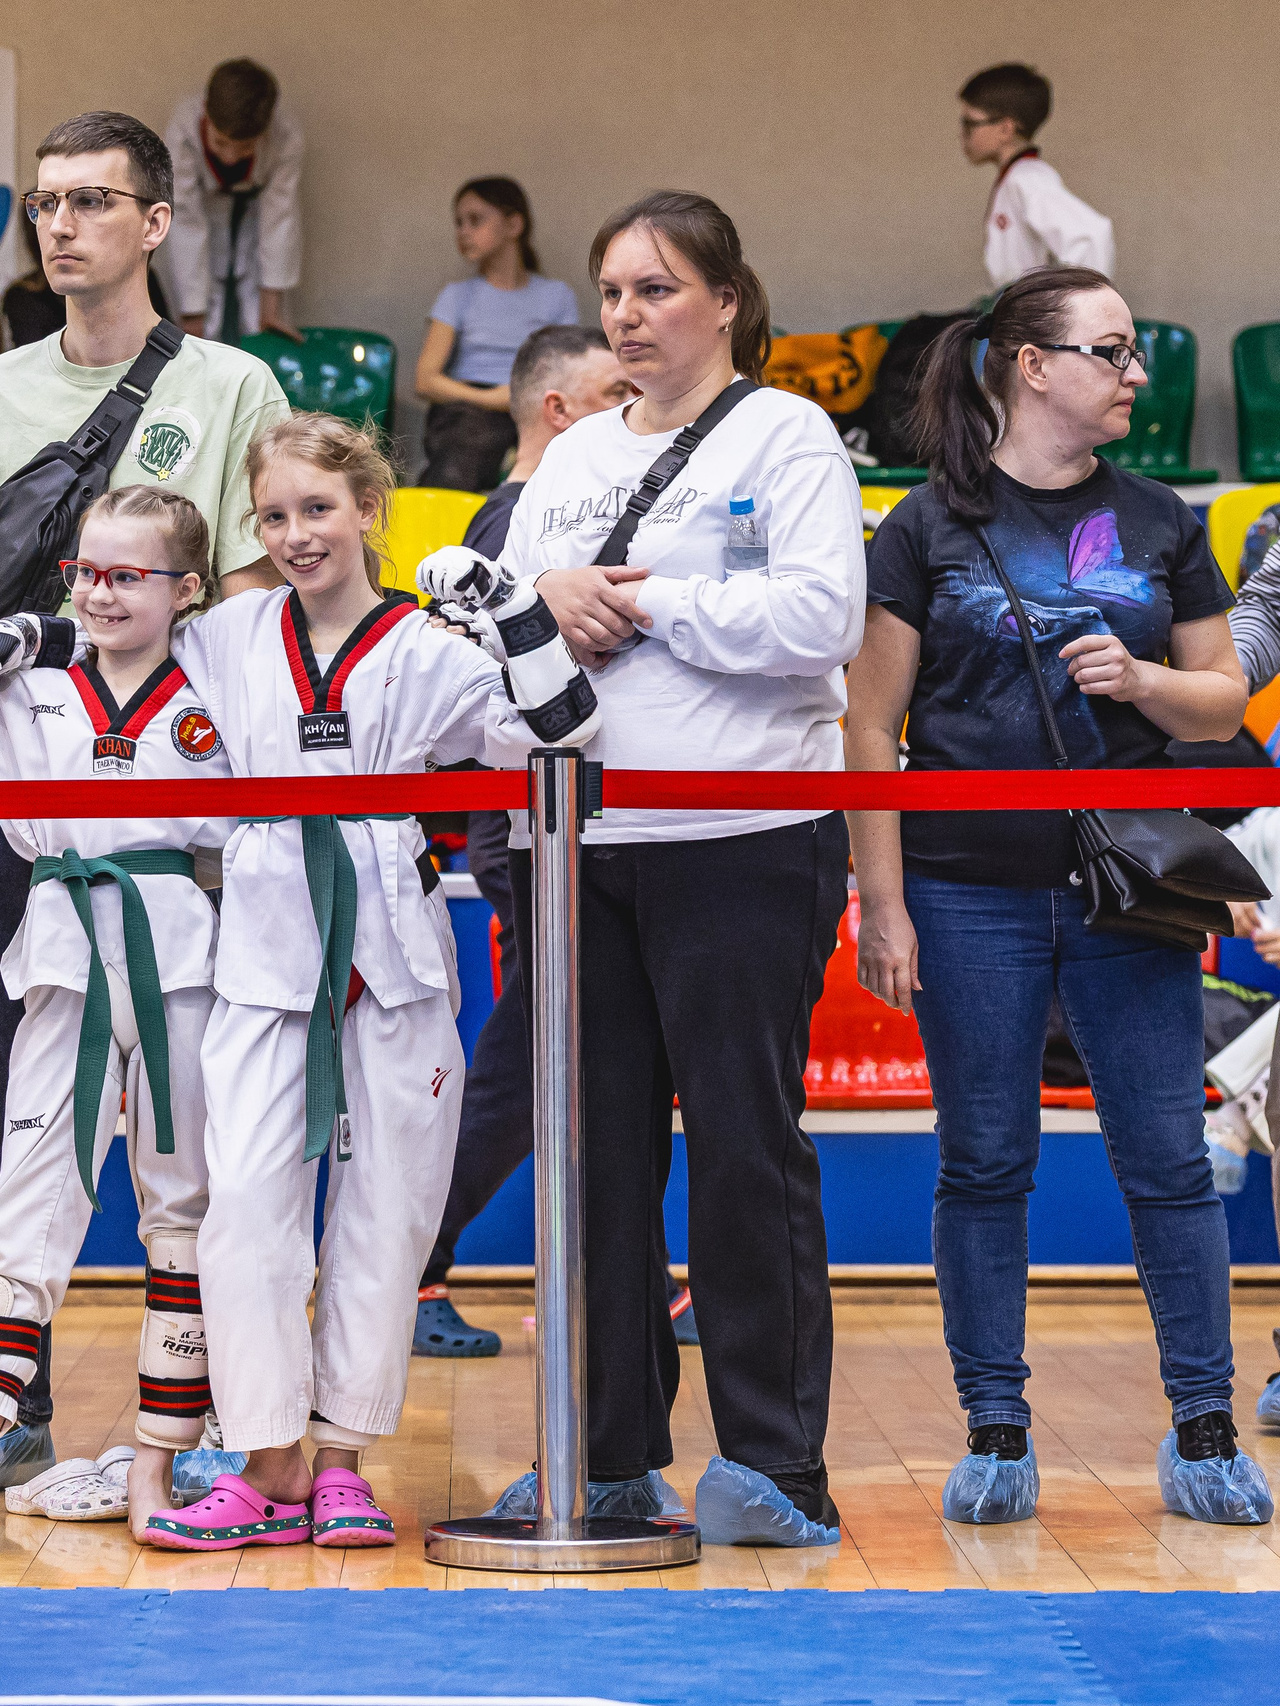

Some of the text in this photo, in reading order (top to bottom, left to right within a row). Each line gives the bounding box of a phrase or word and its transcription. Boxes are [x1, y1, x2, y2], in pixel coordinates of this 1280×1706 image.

[304, 719, 345, 737] KHAN
[96, 738, 132, 757] KHAN
[96, 758, 131, 771] TAEKWONDO
[7, 1112, 46, 1137] KHAN
[162, 1339, 208, 1357] RAPI
